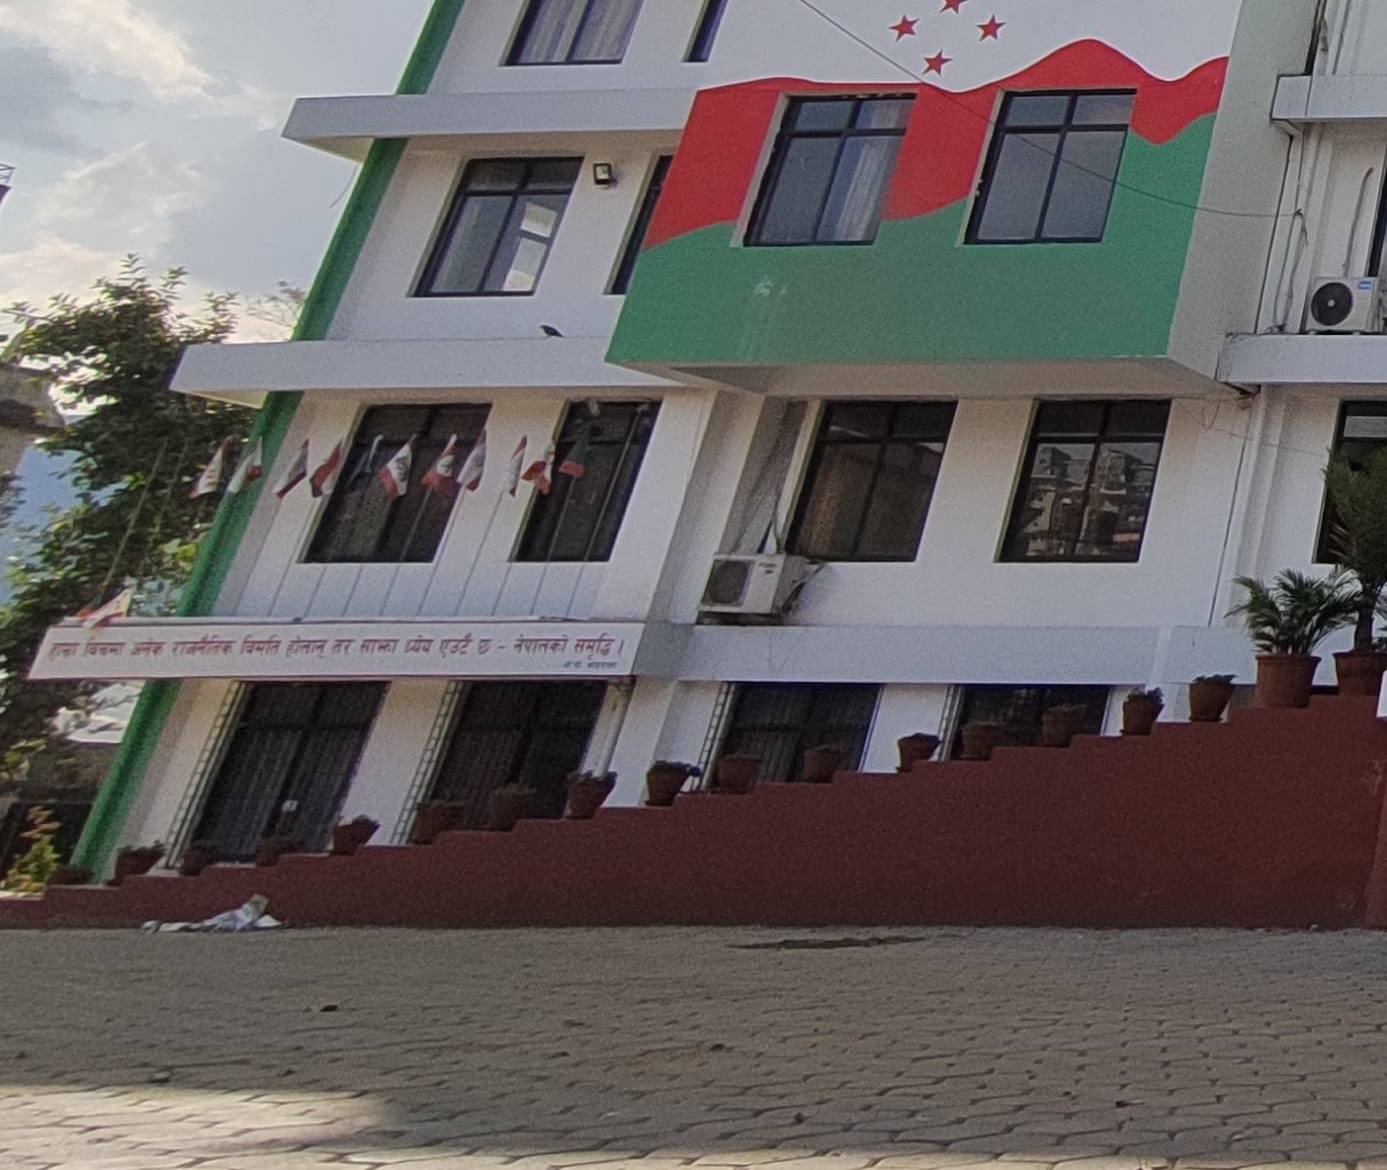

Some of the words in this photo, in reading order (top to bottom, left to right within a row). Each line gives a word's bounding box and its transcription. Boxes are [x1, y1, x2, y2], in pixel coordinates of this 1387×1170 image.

[130, 638, 168, 656] अनेक
[331, 638, 356, 656] तर
[438, 632, 474, 659] एउटै
[477, 638, 494, 656] छ
[513, 634, 570, 656] नेपालको
